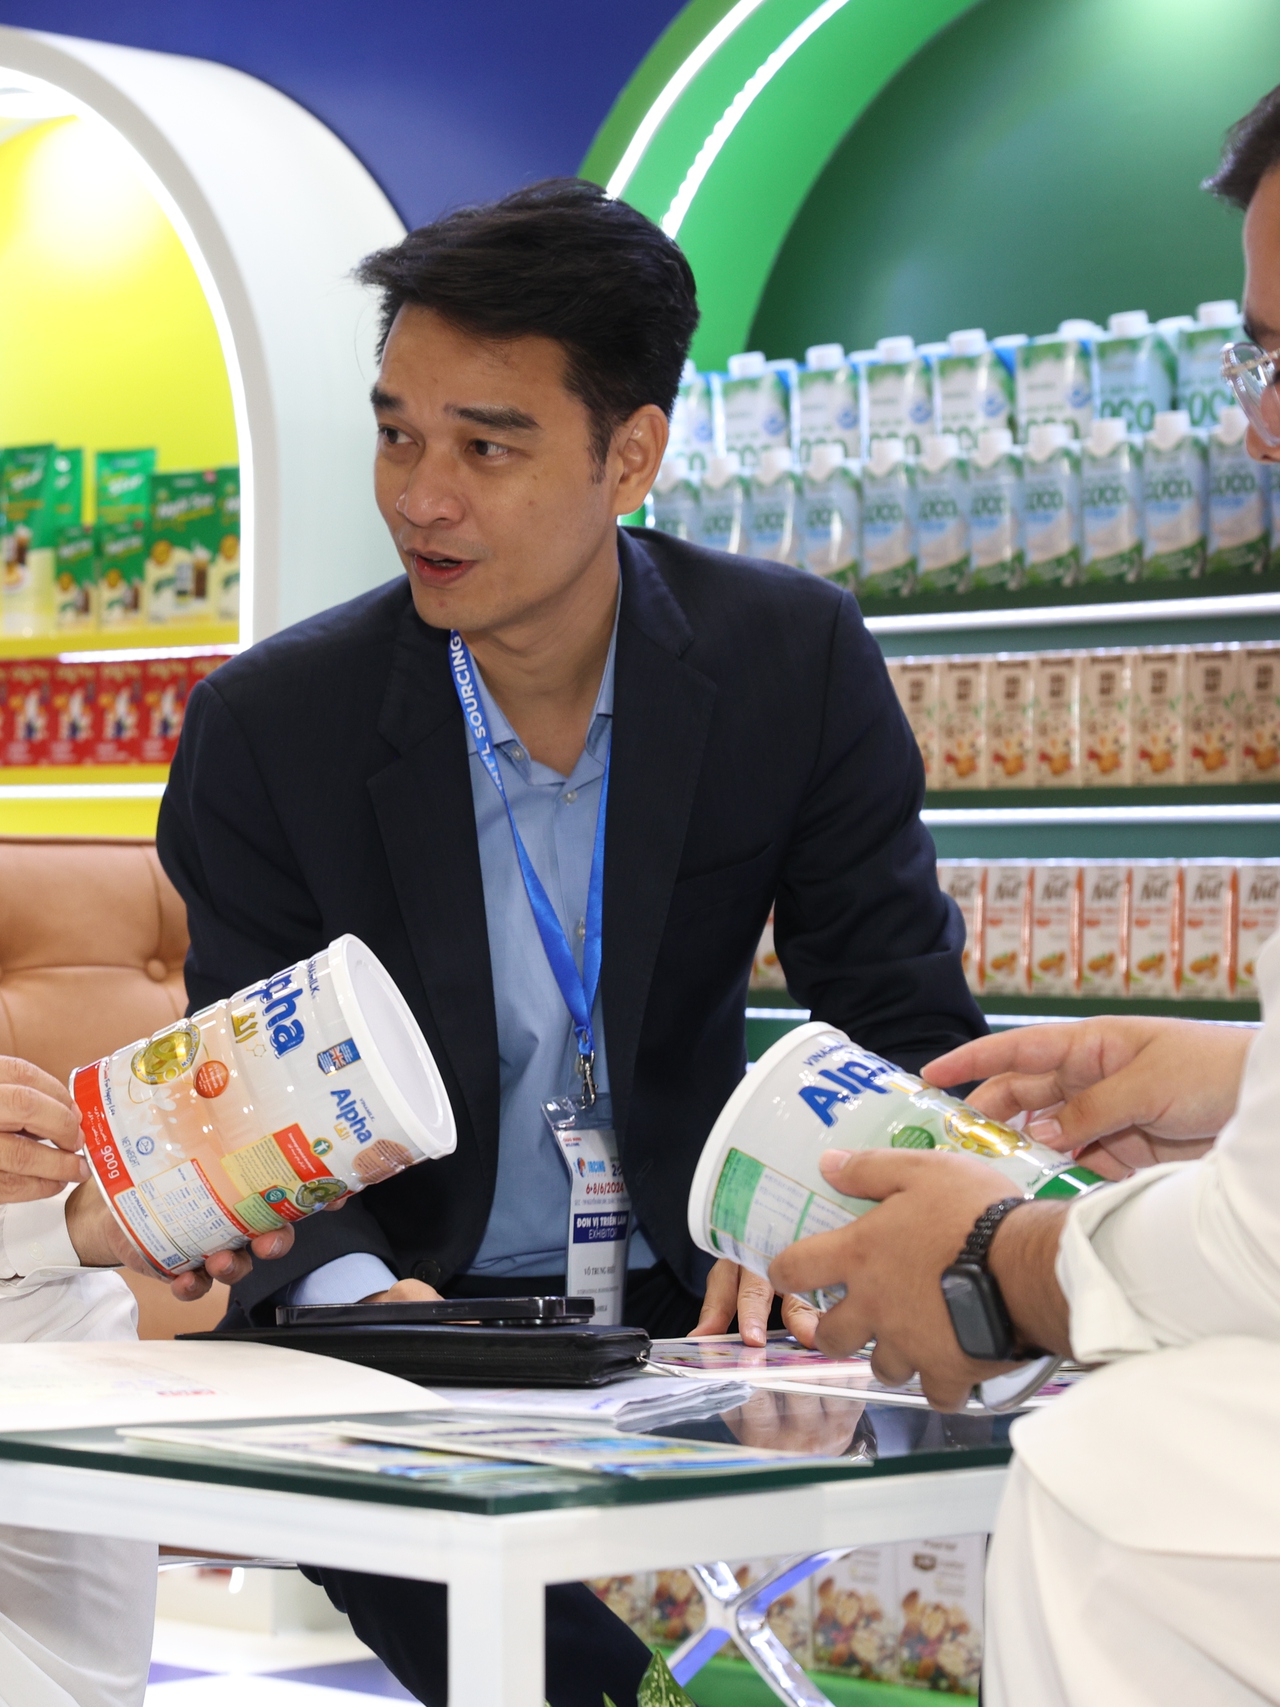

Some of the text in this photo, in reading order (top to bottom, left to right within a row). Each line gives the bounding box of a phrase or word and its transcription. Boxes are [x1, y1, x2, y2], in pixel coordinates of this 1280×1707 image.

[450, 635, 486, 739] SOURCING
[307, 960, 320, 997] NAMILK
[244, 966, 305, 1059] pha
[330, 1088, 373, 1145] Alpha
[798, 1055, 902, 1128] Alp
[100, 1144, 120, 1179] 900g
